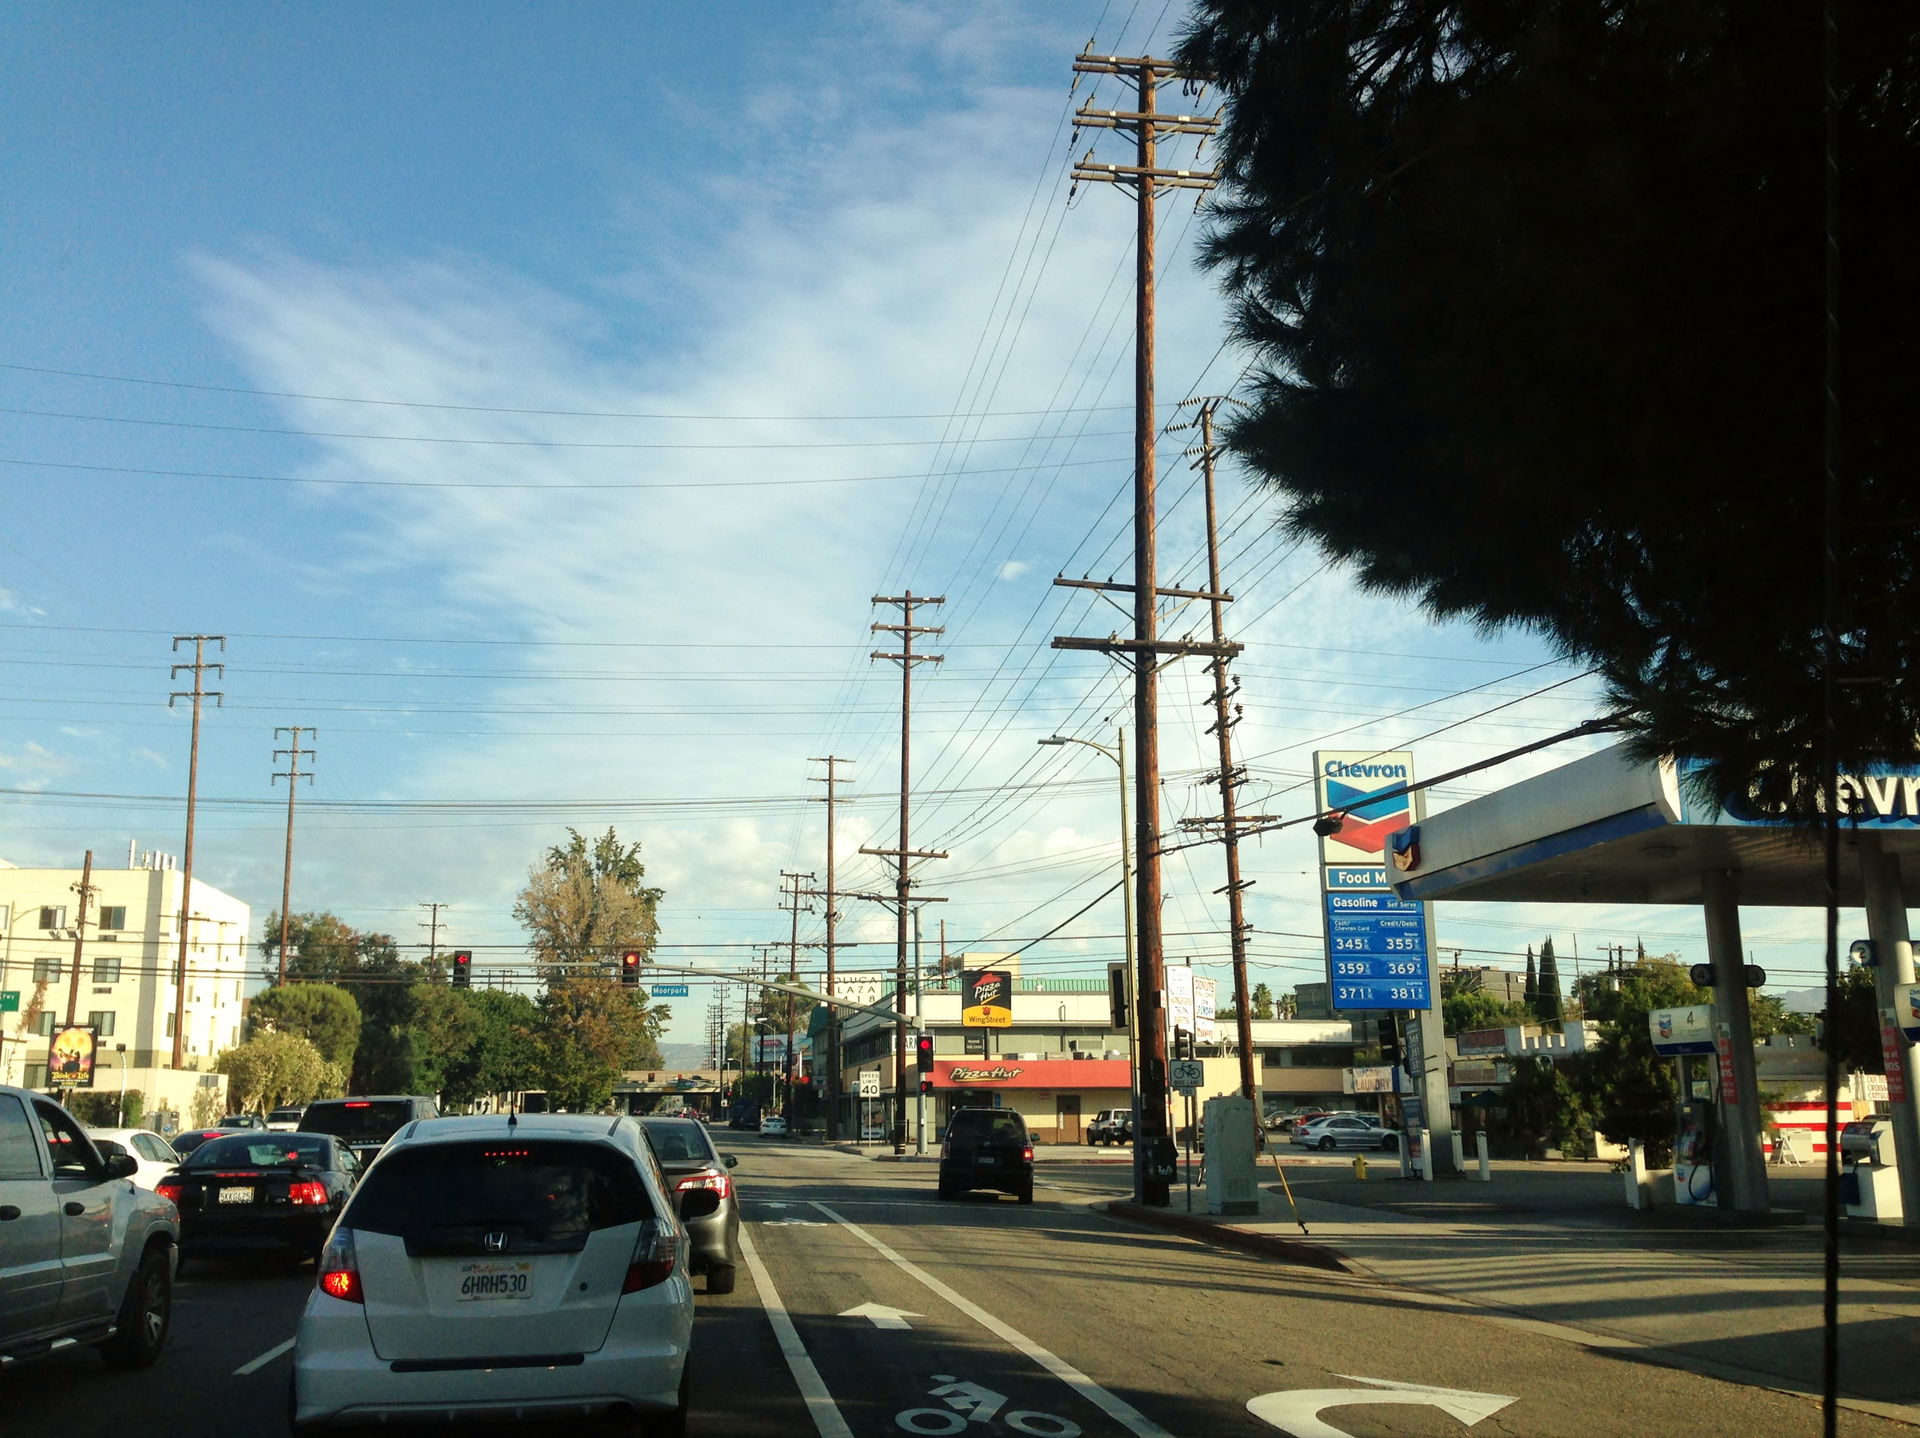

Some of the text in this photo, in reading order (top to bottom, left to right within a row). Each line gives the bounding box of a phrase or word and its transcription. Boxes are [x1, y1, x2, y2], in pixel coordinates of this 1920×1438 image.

[1325, 760, 1407, 778] Chevron
[1339, 871, 1370, 884] Food
[1333, 897, 1378, 908] Gasoline
[1336, 938, 1363, 950] 345
[1386, 938, 1413, 950] 355
[1338, 963, 1364, 975] 359
[1388, 963, 1415, 975] 369
[837, 976, 878, 984] OLUCA
[1195, 979, 1215, 993] DONUTS
[653, 987, 688, 995] Moorpark
[838, 986, 876, 994] LAZA
[974, 982, 1000, 998] Pizza
[980, 989, 999, 1001] Hut
[1339, 988, 1364, 1000] 371
[1391, 988, 1416, 1000] 381
[969, 1016, 1006, 1024] WingStreet
[1686, 1010, 1694, 1026] 4
[949, 1067, 990, 1080] Pizza
[991, 1066, 1023, 1079] Hut
[861, 1085, 878, 1095] 40
[1355, 1079, 1390, 1091] LAUNDRY
[461, 1274, 527, 1294] 6HRH530
